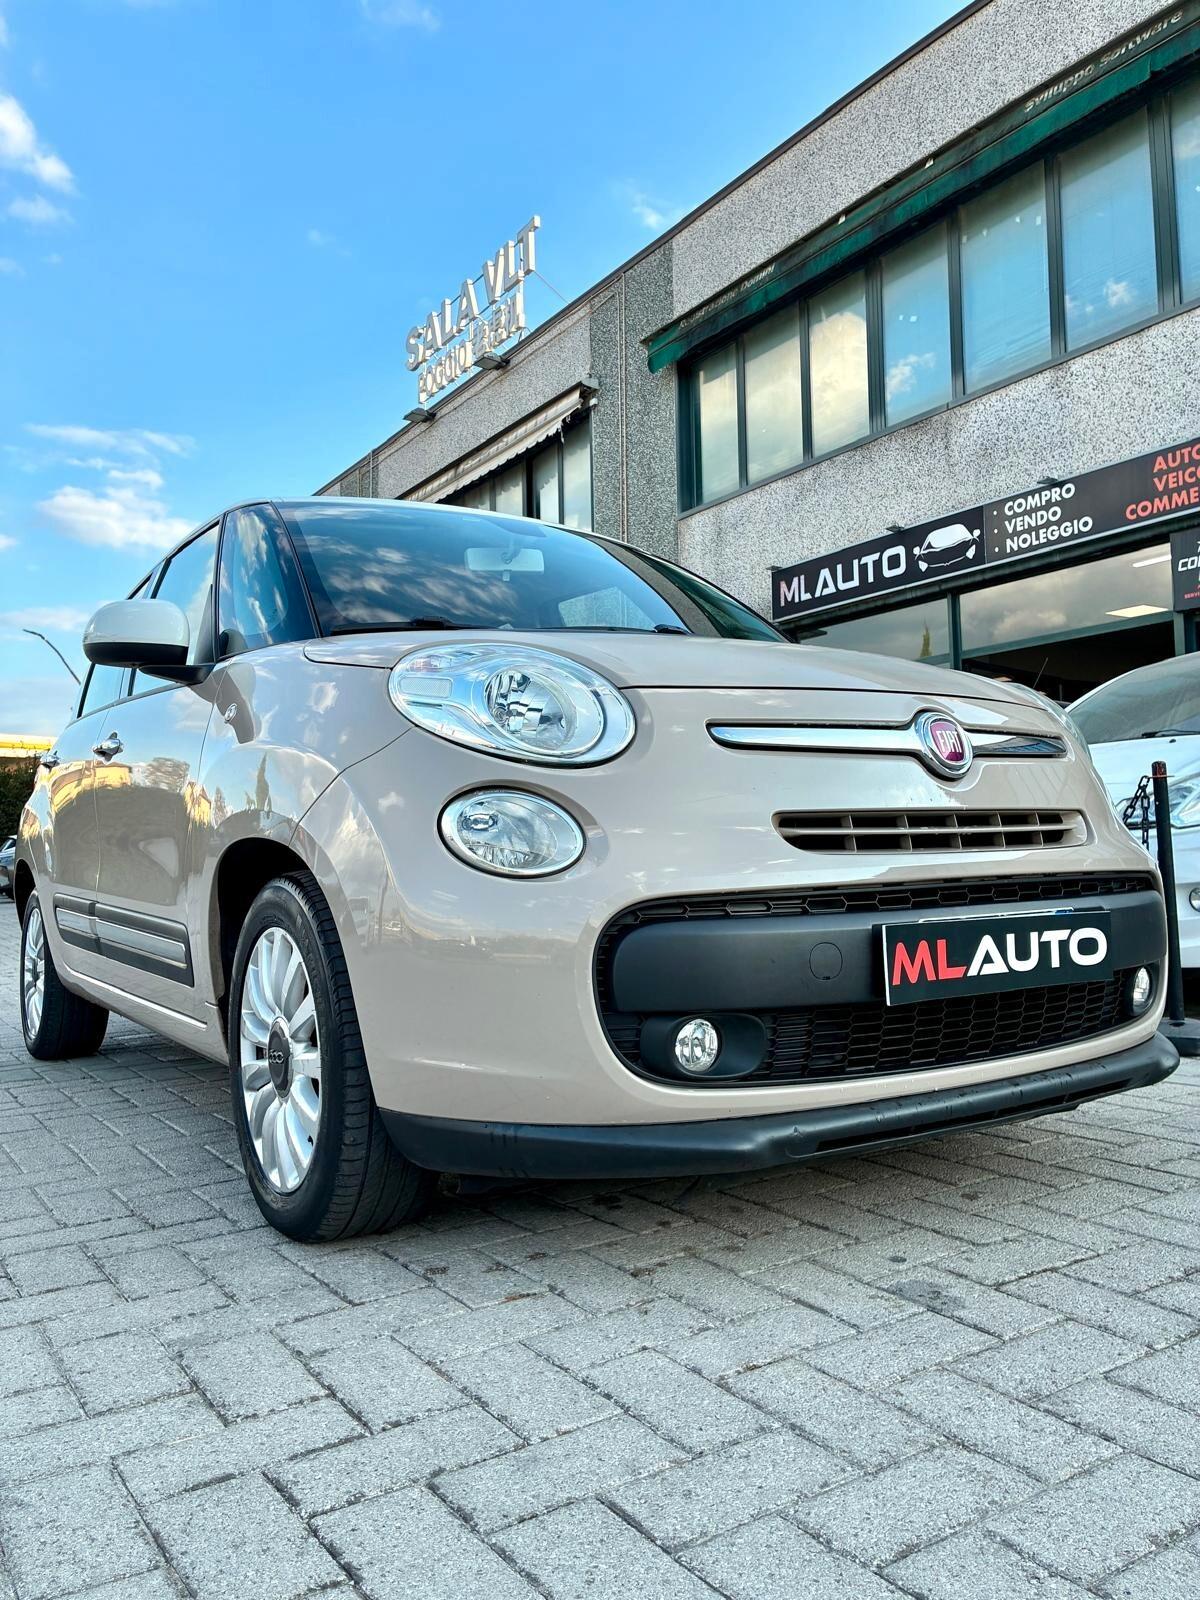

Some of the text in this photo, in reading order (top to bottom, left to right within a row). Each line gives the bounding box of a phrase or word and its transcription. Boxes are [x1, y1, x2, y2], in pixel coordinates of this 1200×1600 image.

[406, 278, 479, 372] SALA
[1153, 466, 1200, 492] VEIC
[1004, 483, 1076, 516] COMPRO
[1125, 487, 1200, 520] COMME
[1004, 506, 1062, 534] VENDO
[1005, 516, 1093, 554] NOLEGGIO
[935, 729, 963, 753] FIAT
